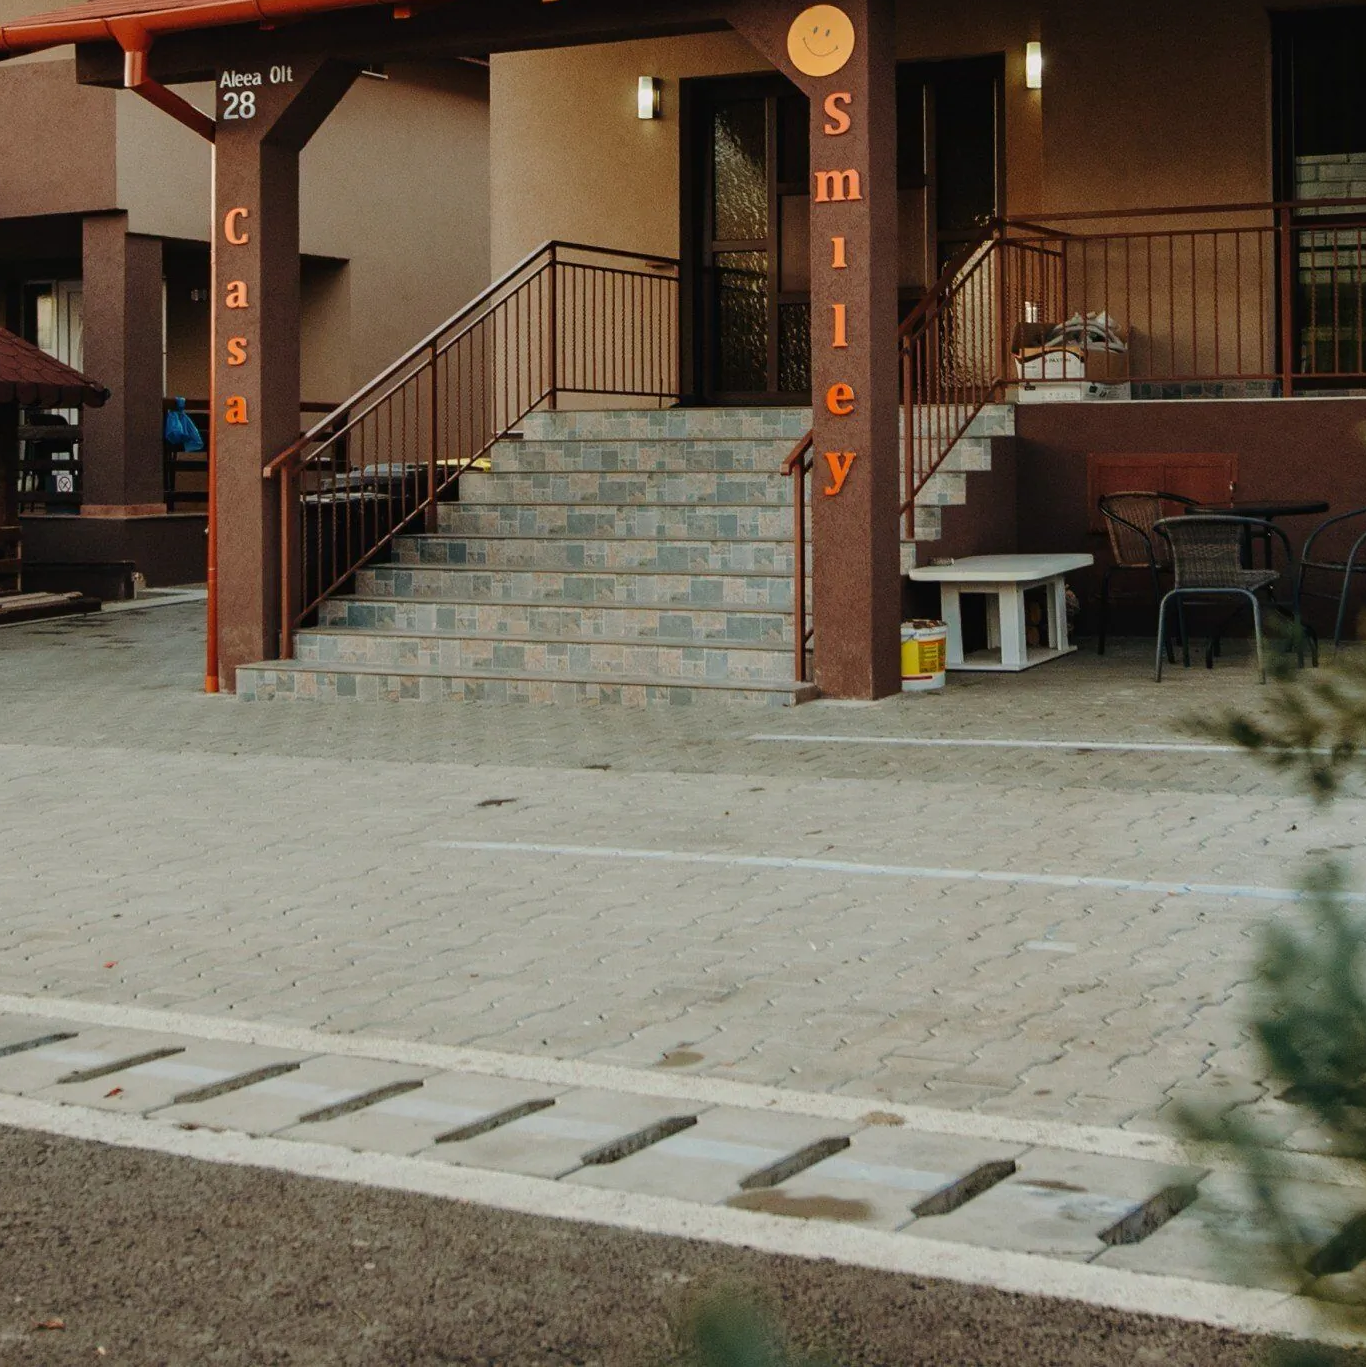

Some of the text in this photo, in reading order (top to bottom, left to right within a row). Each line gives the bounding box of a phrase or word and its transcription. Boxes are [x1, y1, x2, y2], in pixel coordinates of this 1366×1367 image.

[220, 65, 293, 88] Aleea Olt
[223, 91, 256, 120] 28
[224, 207, 249, 425] Casa
[814, 92, 863, 496] Smiley
